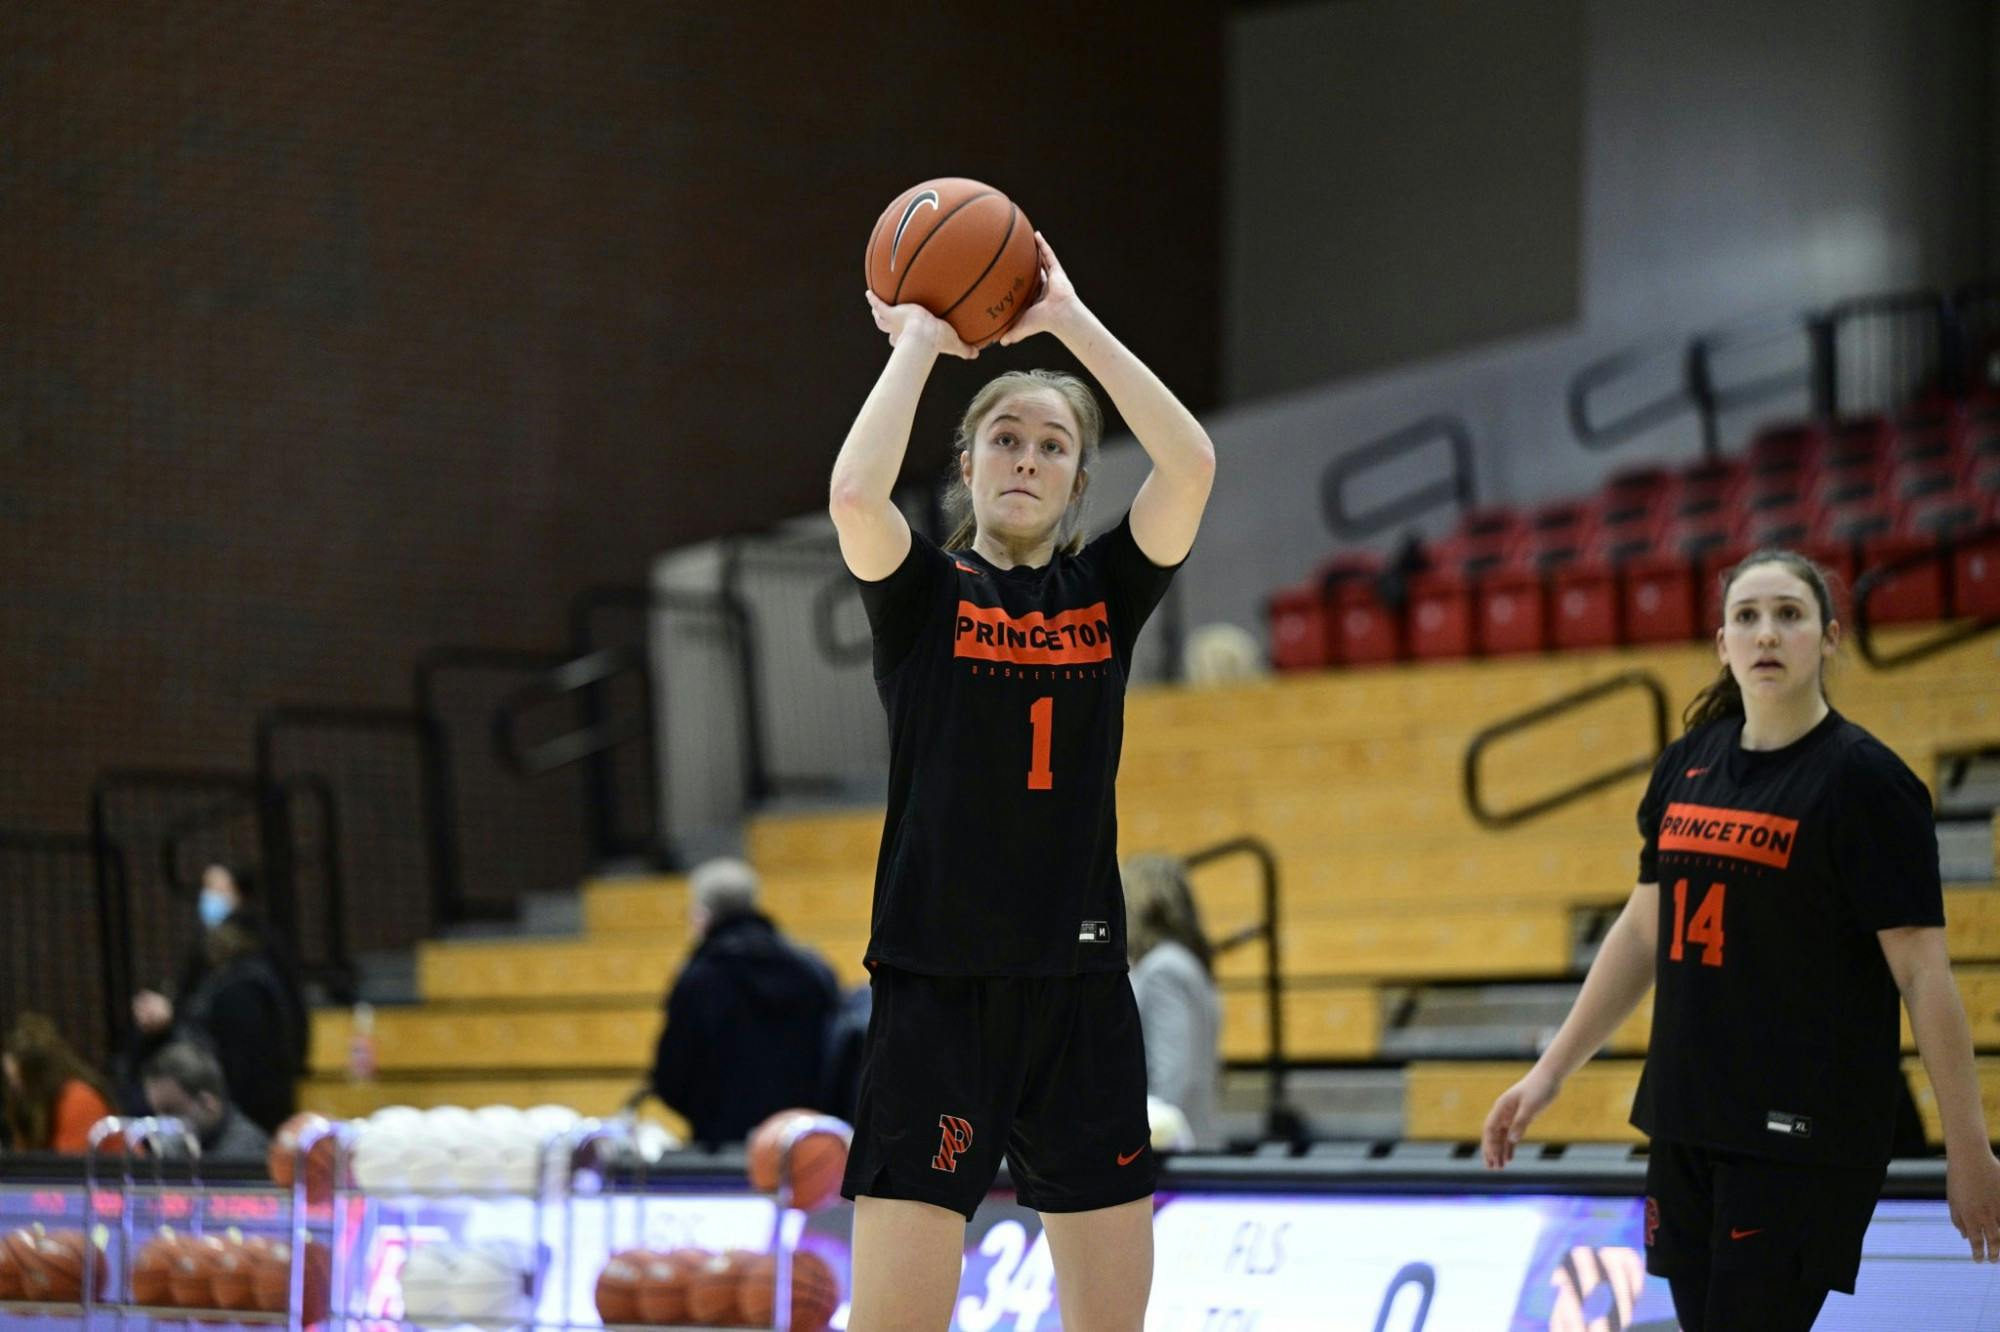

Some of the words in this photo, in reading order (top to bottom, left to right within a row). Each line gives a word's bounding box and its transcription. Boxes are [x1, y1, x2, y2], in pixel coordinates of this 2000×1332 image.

[956, 616, 1112, 651] PRINCETON
[1027, 697, 1053, 789] 1
[1660, 815, 1792, 854] PRINCETON
[1099, 927, 1106, 937] M
[1670, 878, 1725, 965] 14
[932, 1114, 974, 1173] P
